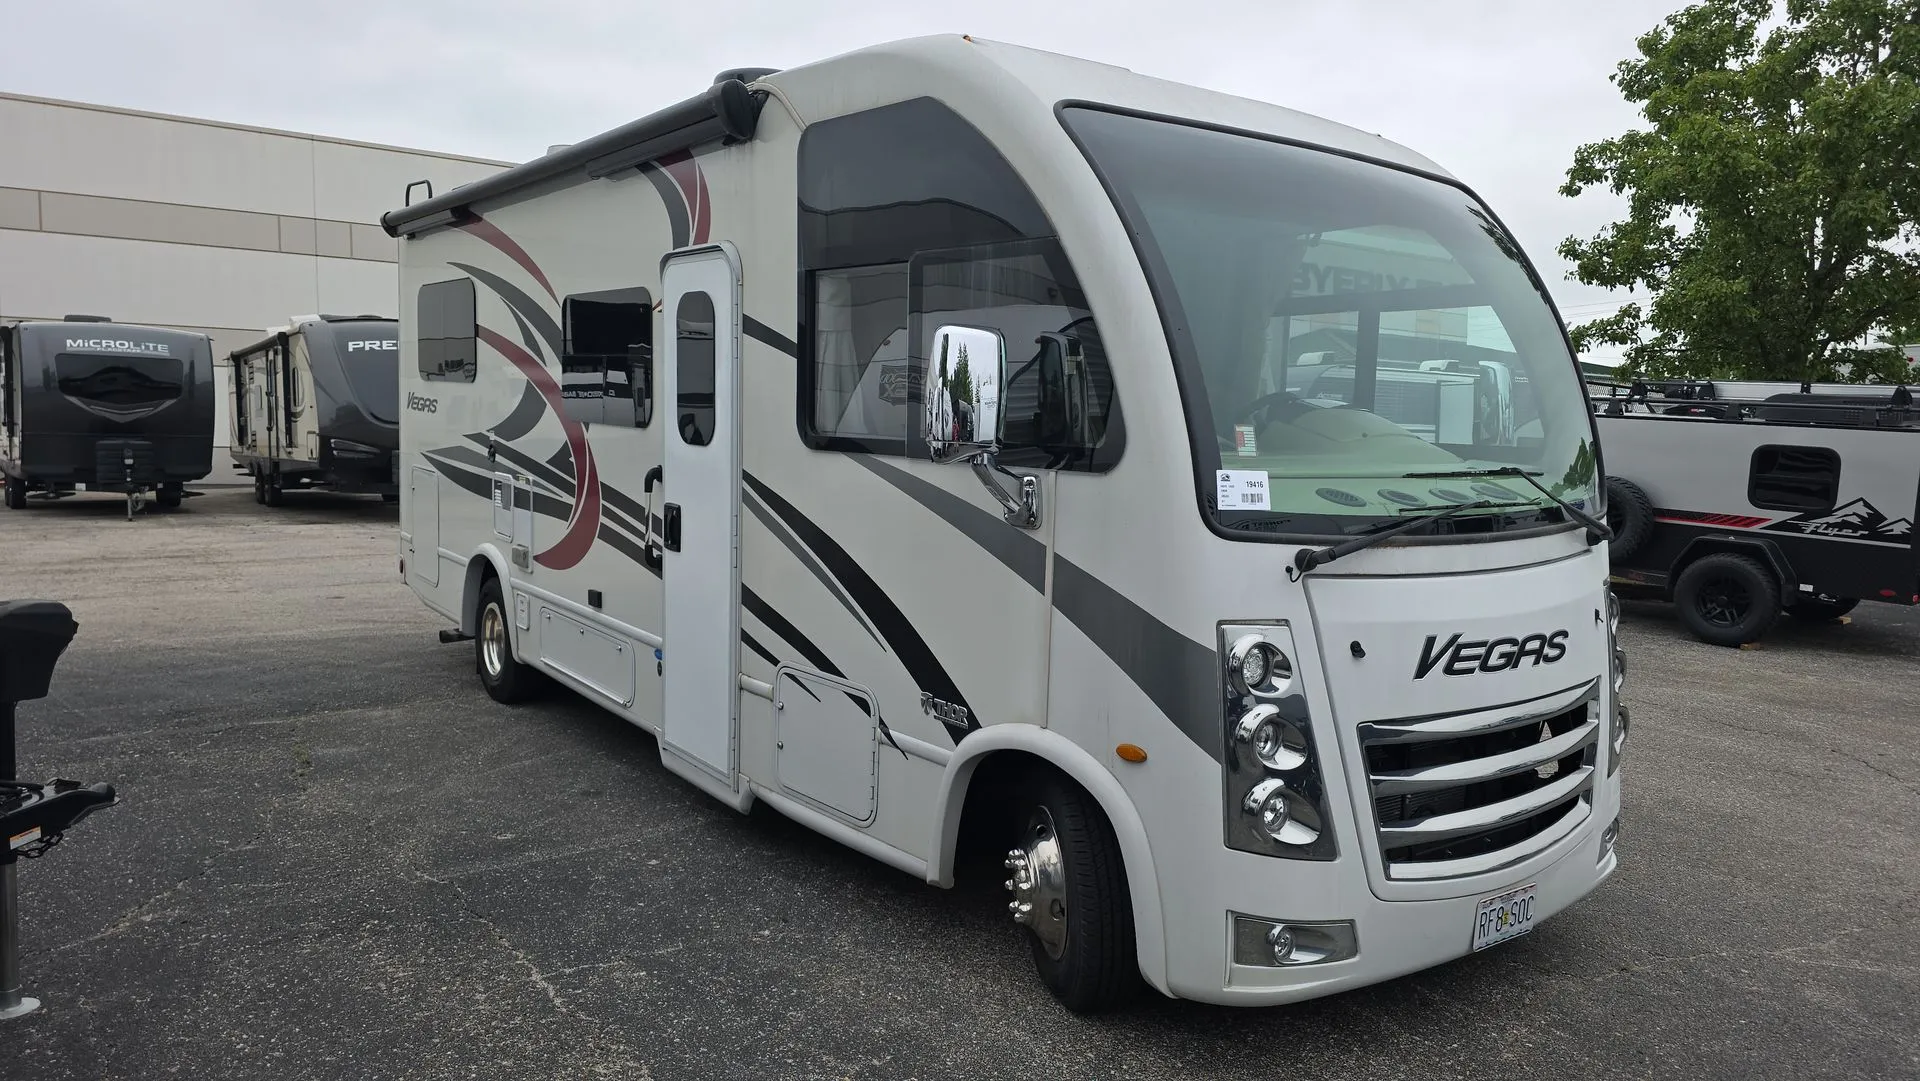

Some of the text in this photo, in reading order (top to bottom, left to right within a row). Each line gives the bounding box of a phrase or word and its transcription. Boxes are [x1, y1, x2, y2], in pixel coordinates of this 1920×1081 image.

[348, 340, 400, 352] PRE
[406, 391, 438, 414] VEGAS
[1412, 628, 1569, 681] VEGAS
[934, 698, 968, 724] THOR
